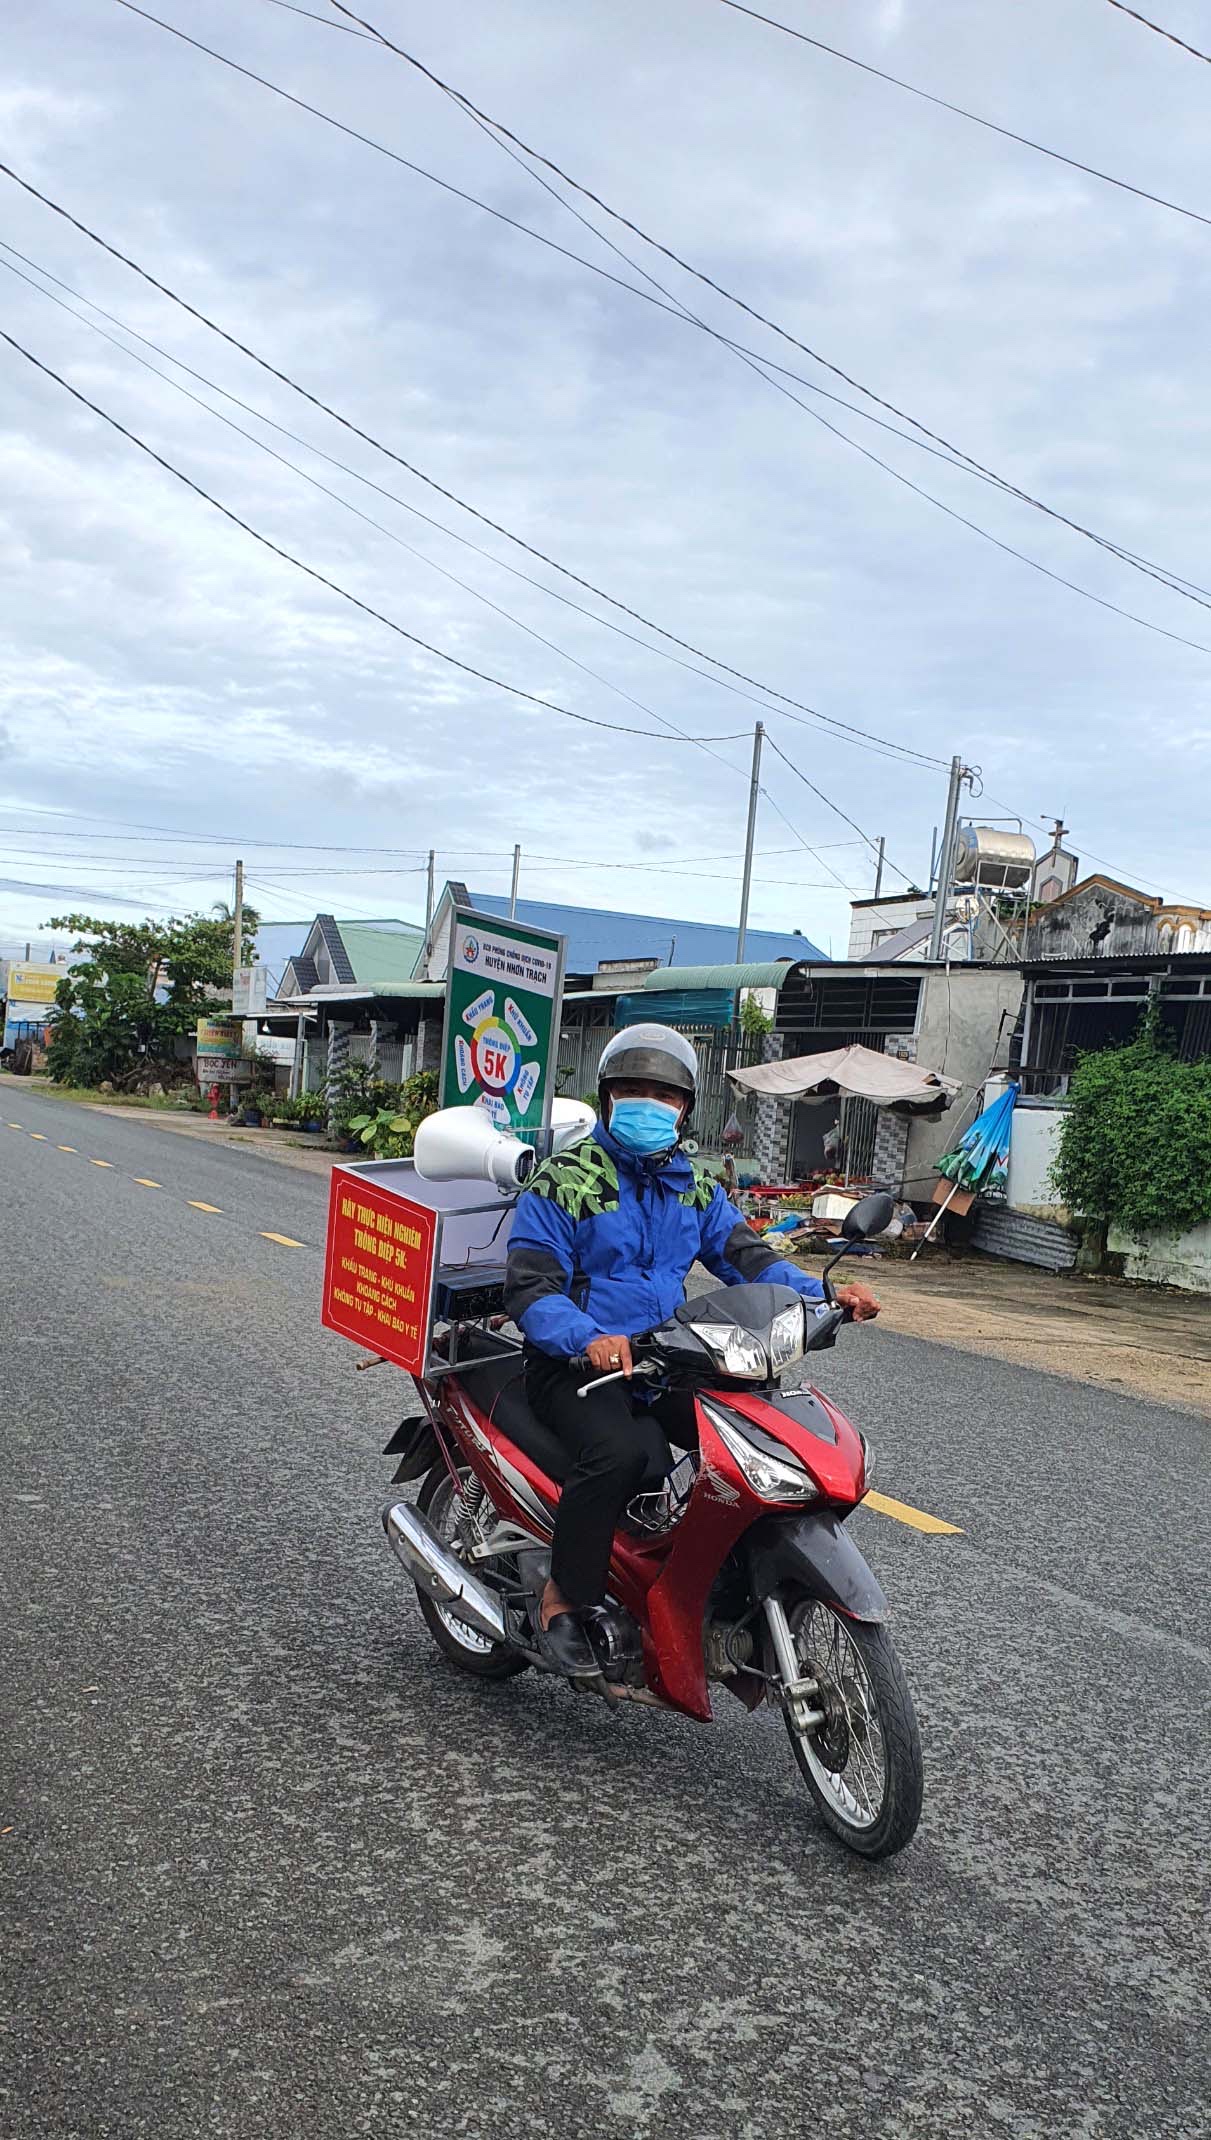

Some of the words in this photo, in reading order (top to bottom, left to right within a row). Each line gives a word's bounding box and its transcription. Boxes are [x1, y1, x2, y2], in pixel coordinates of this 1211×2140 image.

[485, 955, 505, 973] HUYỆN
[506, 963, 525, 977] NHƠN
[526, 967, 547, 984] TRẠCH
[484, 1049, 507, 1081] 5K
[341, 1196, 356, 1219] HÃY
[357, 1204, 376, 1229] THỰC
[376, 1213, 393, 1238] HIỆN
[393, 1221, 421, 1251] NGHIÊM
[354, 1228, 377, 1255] THÔNG
[378, 1239, 394, 1264] ĐIỆP
[341, 1256, 358, 1274] KHẨU
[358, 1264, 377, 1284] TRANG
[333, 1286, 354, 1307] KHÔNG
[377, 1309, 391, 1326] KHAI
[391, 1316, 404, 1333] BÁO
[405, 1323, 410, 1336] Y
[410, 1325, 418, 1340] TẾ
[381, 1293, 397, 1311] CÁCH
[704, 1492, 740, 1508] HONDA
